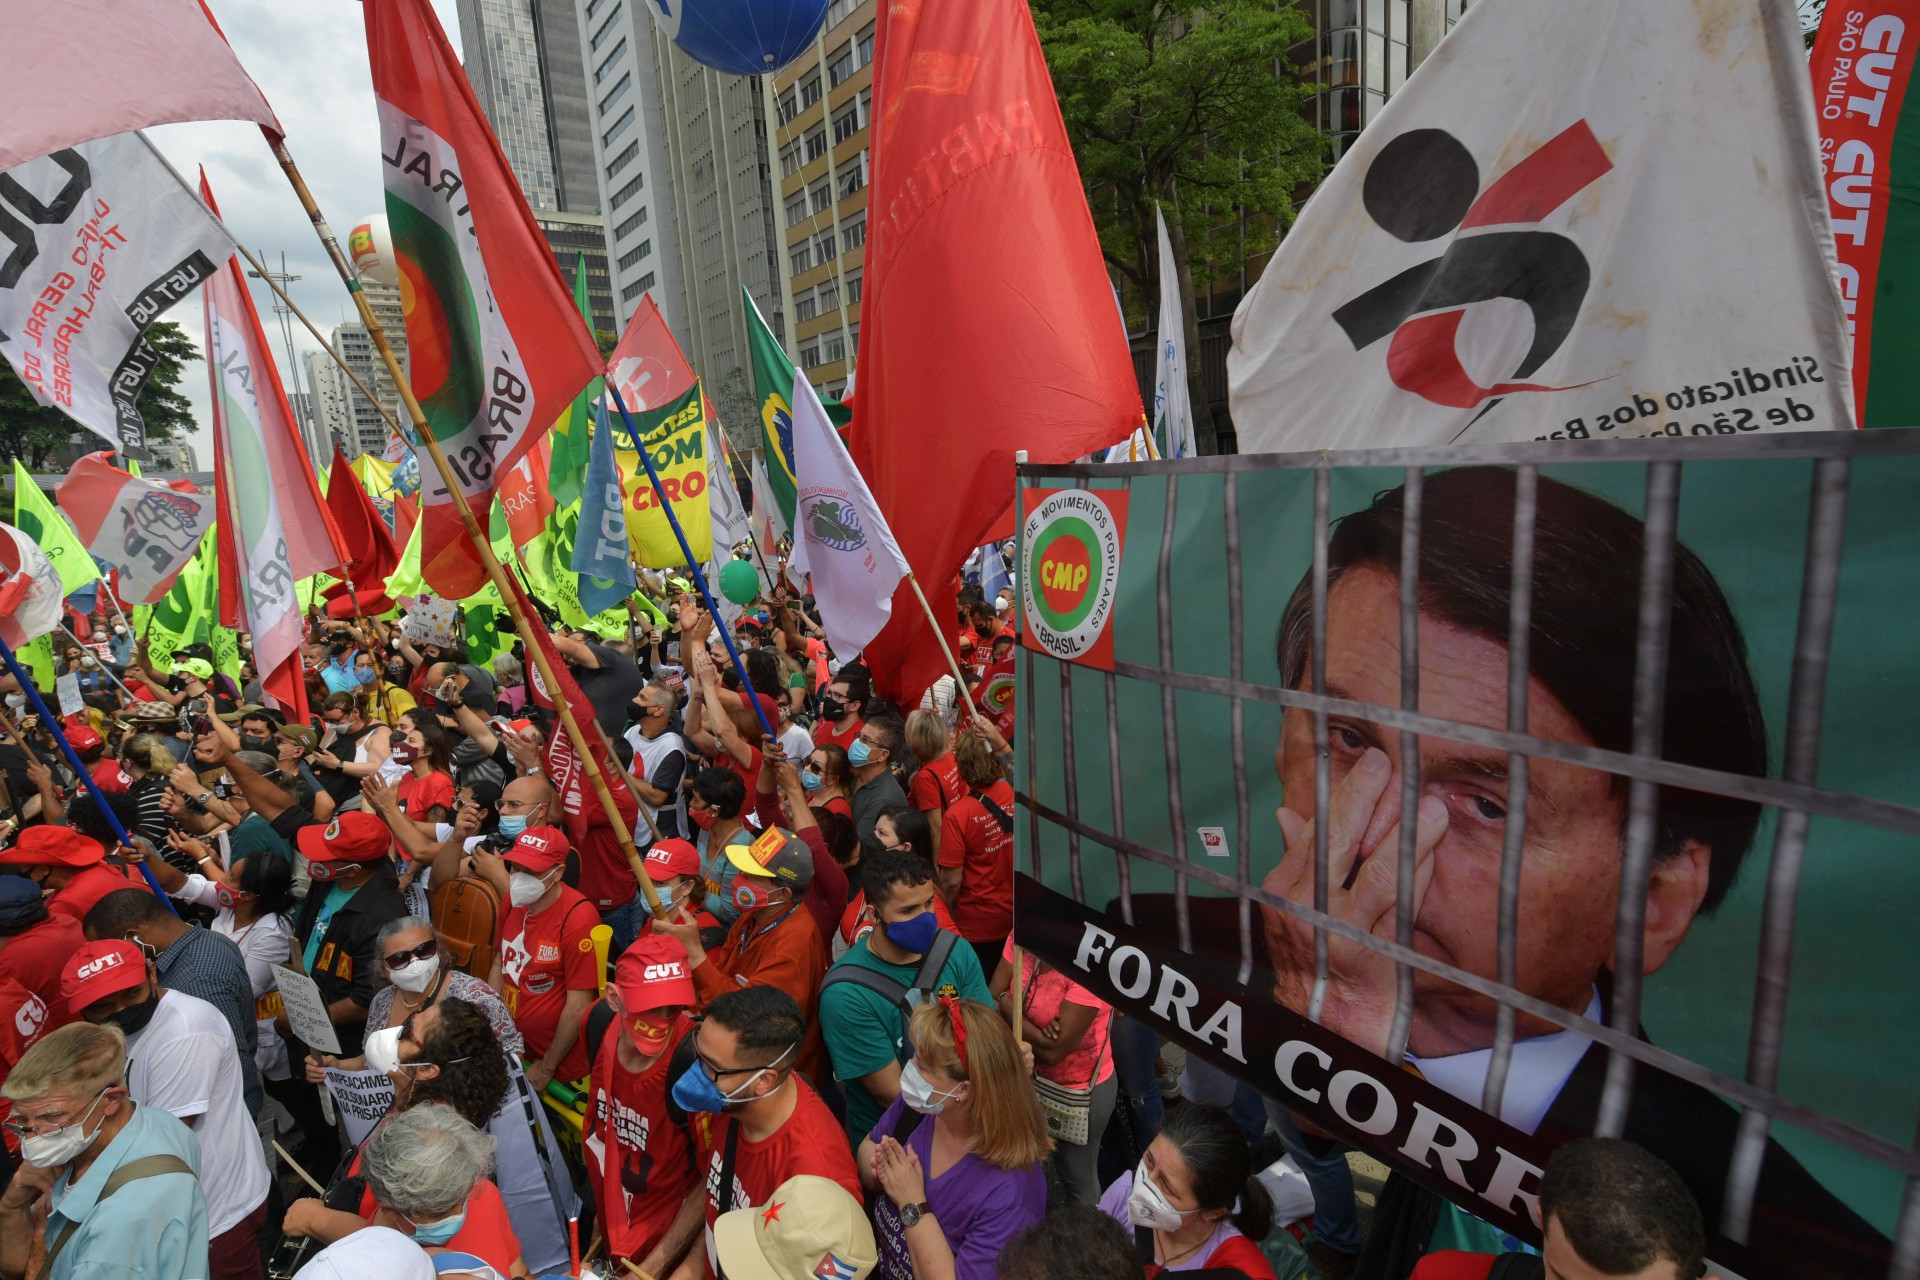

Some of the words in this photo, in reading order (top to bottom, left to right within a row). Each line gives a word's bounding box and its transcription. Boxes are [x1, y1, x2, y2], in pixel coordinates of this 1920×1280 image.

[1838, 10, 1864, 52] SÃO
[1849, 15, 1905, 128] CUT
[1822, 57, 1852, 121] PAULO
[1830, 139, 1875, 247] CUT
[635, 430, 703, 477] COM
[632, 470, 706, 512] CIRO
[1026, 518, 1039, 539] DE
[1041, 496, 1108, 529] MOVIMENTOS
[1023, 546, 1033, 613] CENTRAL
[1041, 559, 1088, 592] CMP
[1091, 531, 1116, 629] POPULARES
[1039, 626, 1082, 655] BRASIL
[520, 834, 545, 848] CUT
[77, 953, 117, 979] CUT
[538, 944, 559, 956] FORA
[644, 962, 681, 980] CUT
[1073, 921, 1248, 1065] FORA
[334, 1091, 394, 1107] BOLSONARO
[340, 1100, 352, 1116] NA
[627, 1120, 647, 1140] DOS
[879, 1194, 901, 1232] Quando
